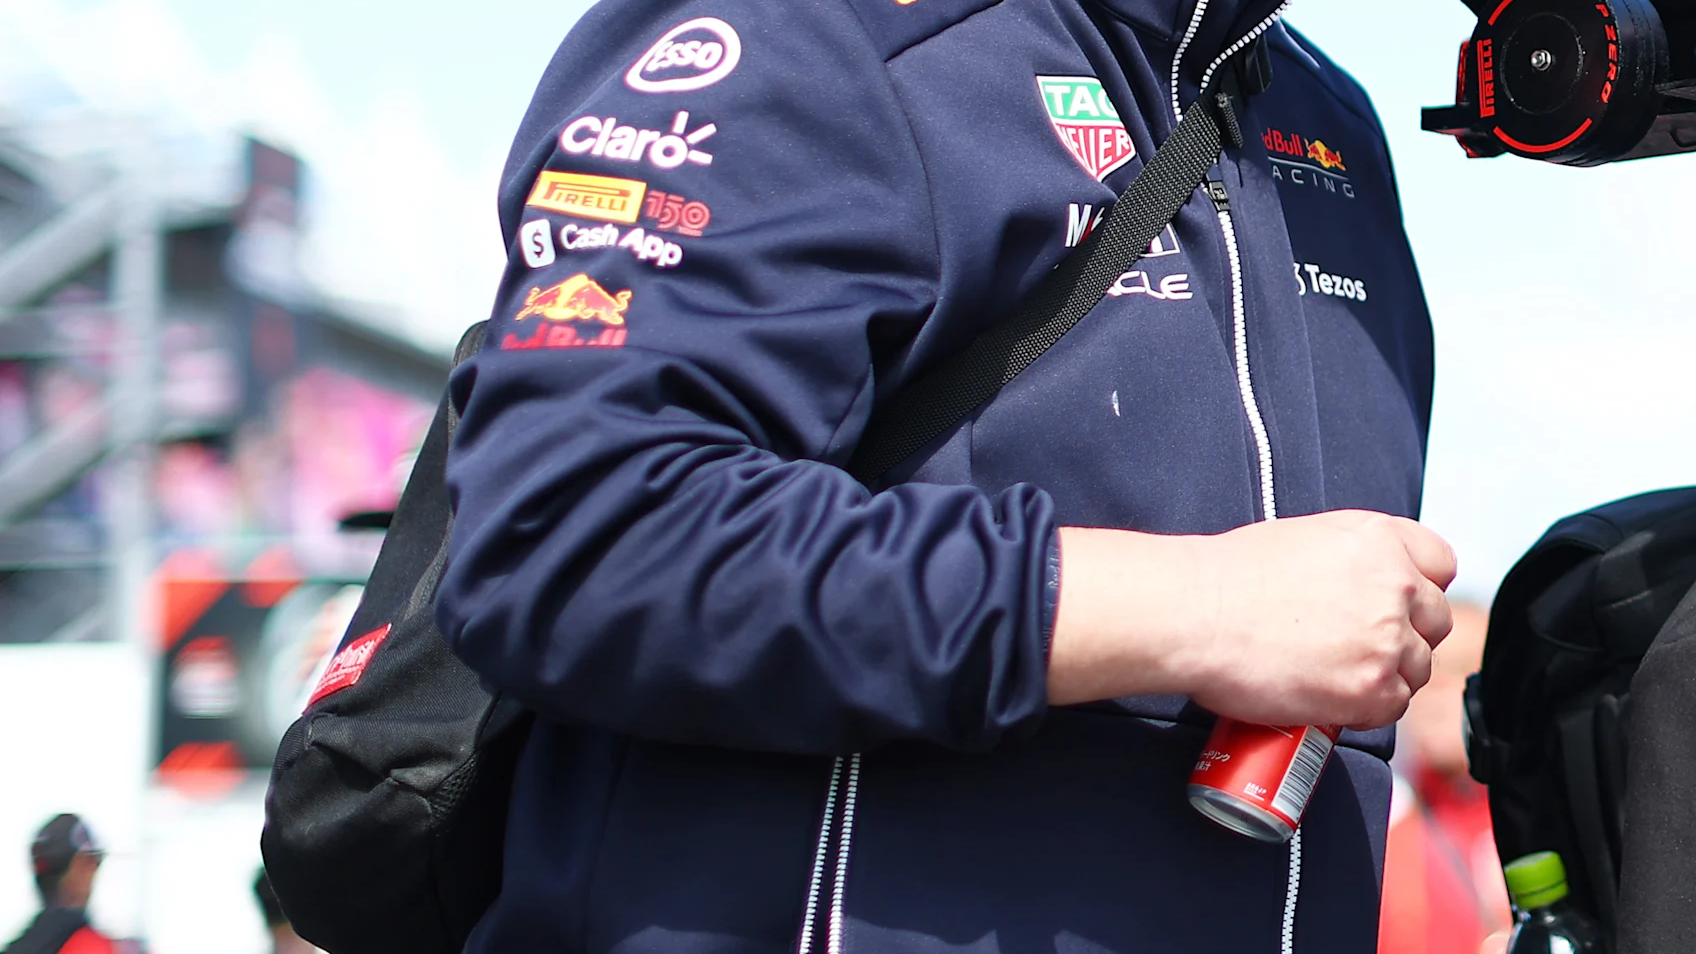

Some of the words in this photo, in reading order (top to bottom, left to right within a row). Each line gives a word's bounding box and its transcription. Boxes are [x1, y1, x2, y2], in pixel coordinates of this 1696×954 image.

[1595, 2, 1611, 18] P
[1477, 37, 1495, 119] PIRELLI
[1600, 28, 1622, 104] ZERO
[559, 112, 702, 170] Claro
[1055, 126, 1131, 177] HEUER
[1272, 129, 1305, 157] Bull
[542, 180, 633, 213] PIRELLI
[1272, 164, 1356, 199] ACING
[560, 222, 620, 251] Cash
[617, 227, 684, 267] App
[1107, 270, 1194, 301] CLE
[1304, 262, 1368, 302] Tezos
